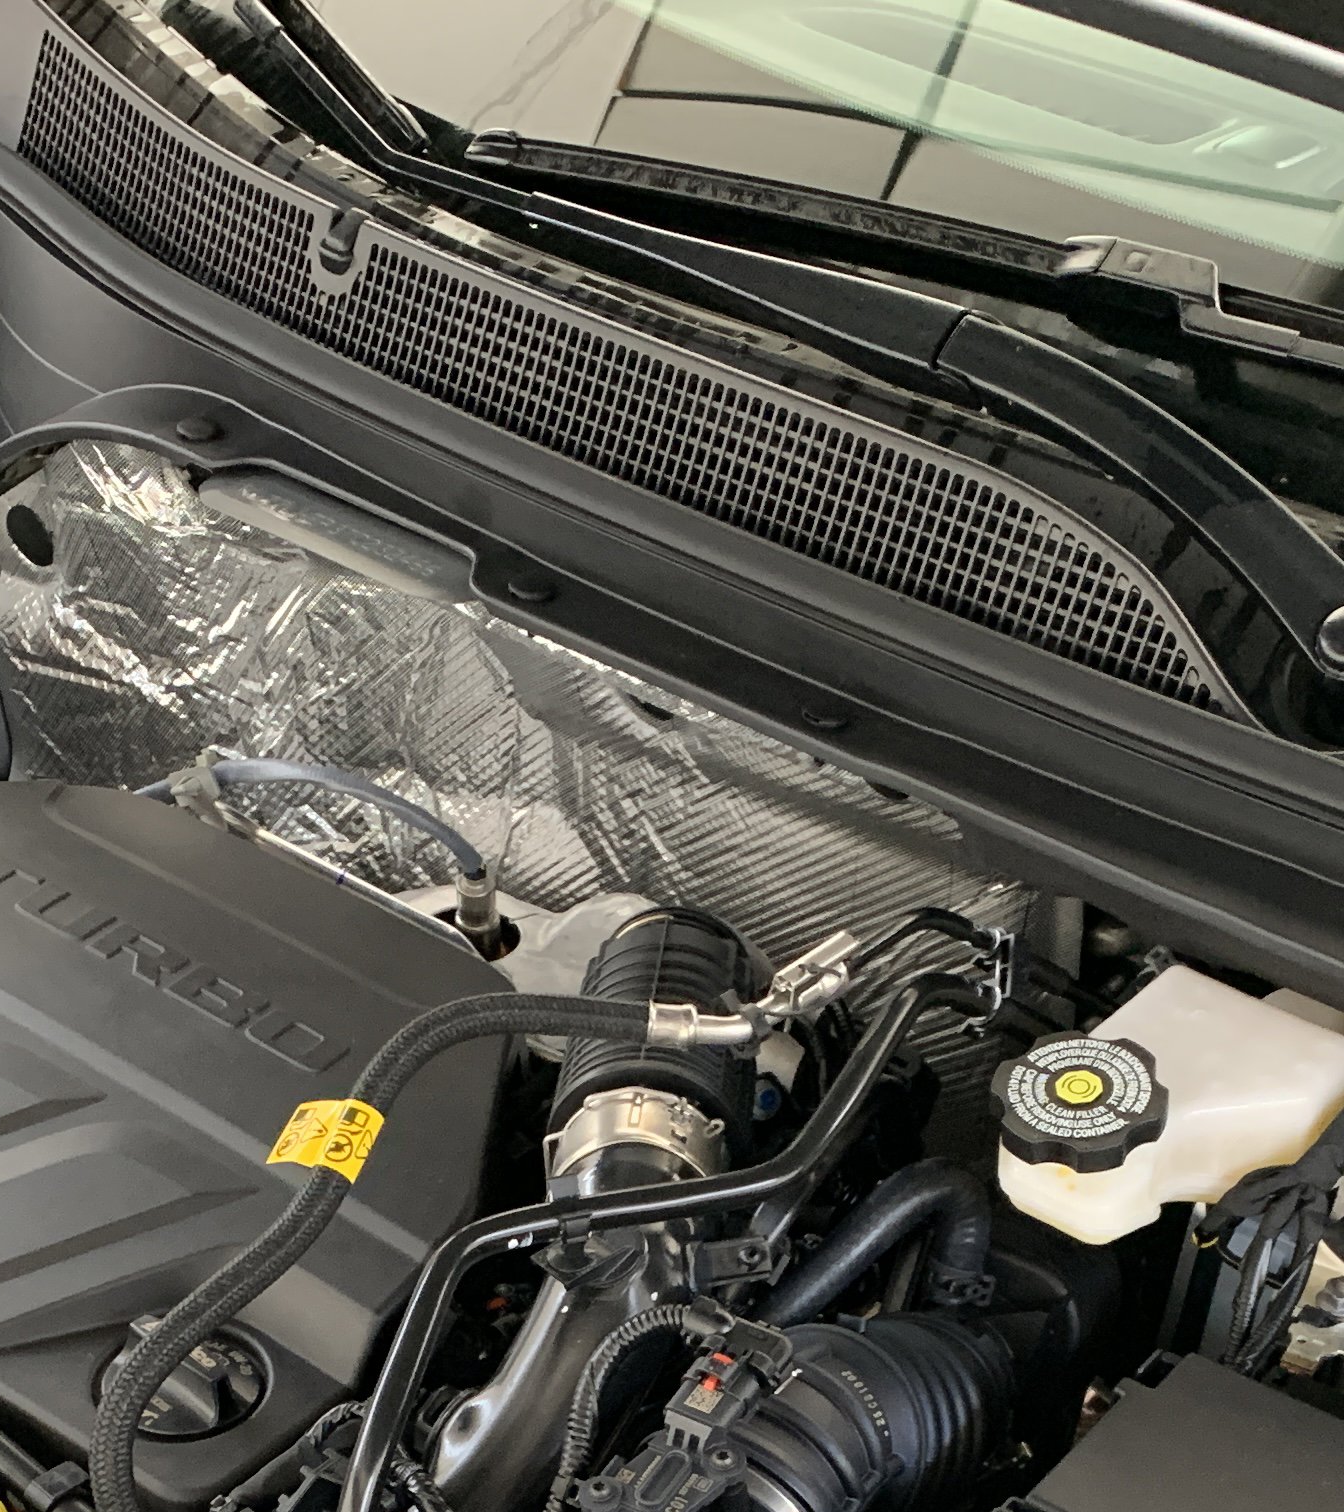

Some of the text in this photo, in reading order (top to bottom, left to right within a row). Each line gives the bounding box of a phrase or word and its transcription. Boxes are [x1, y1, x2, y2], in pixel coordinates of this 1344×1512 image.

[1045, 1102, 1075, 1118] CLEAN
[1075, 1105, 1108, 1119] FILLER
[1092, 1111, 1116, 1126] ONLY
[1012, 1102, 1034, 1122] FROM
[1028, 1118, 1039, 1127] A
[1035, 1121, 1072, 1137] SEALED
